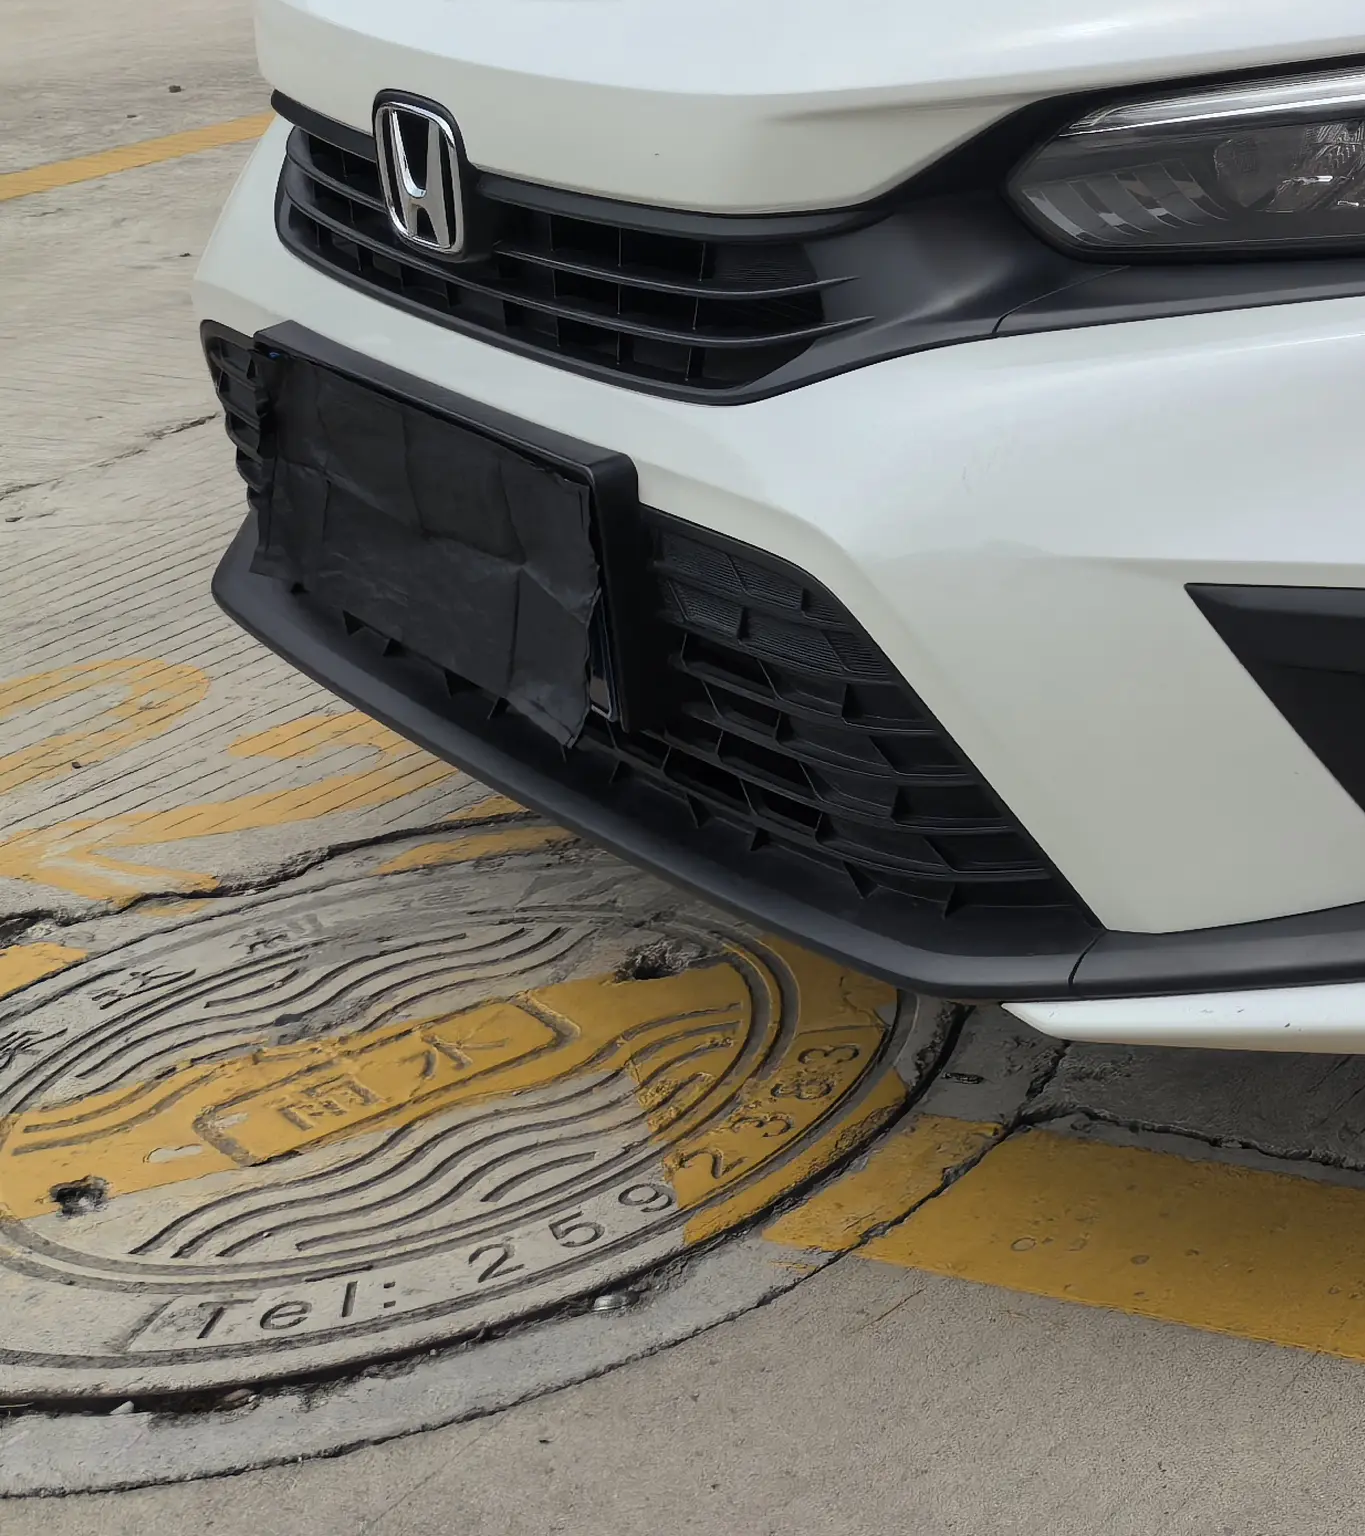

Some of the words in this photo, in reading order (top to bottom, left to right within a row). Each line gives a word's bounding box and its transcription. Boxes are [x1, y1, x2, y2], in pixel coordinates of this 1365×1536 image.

[278, 1009, 510, 1131] 雨水
[197, 1279, 397, 1340] Tel:
[467, 1044, 861, 1284] 2592383
